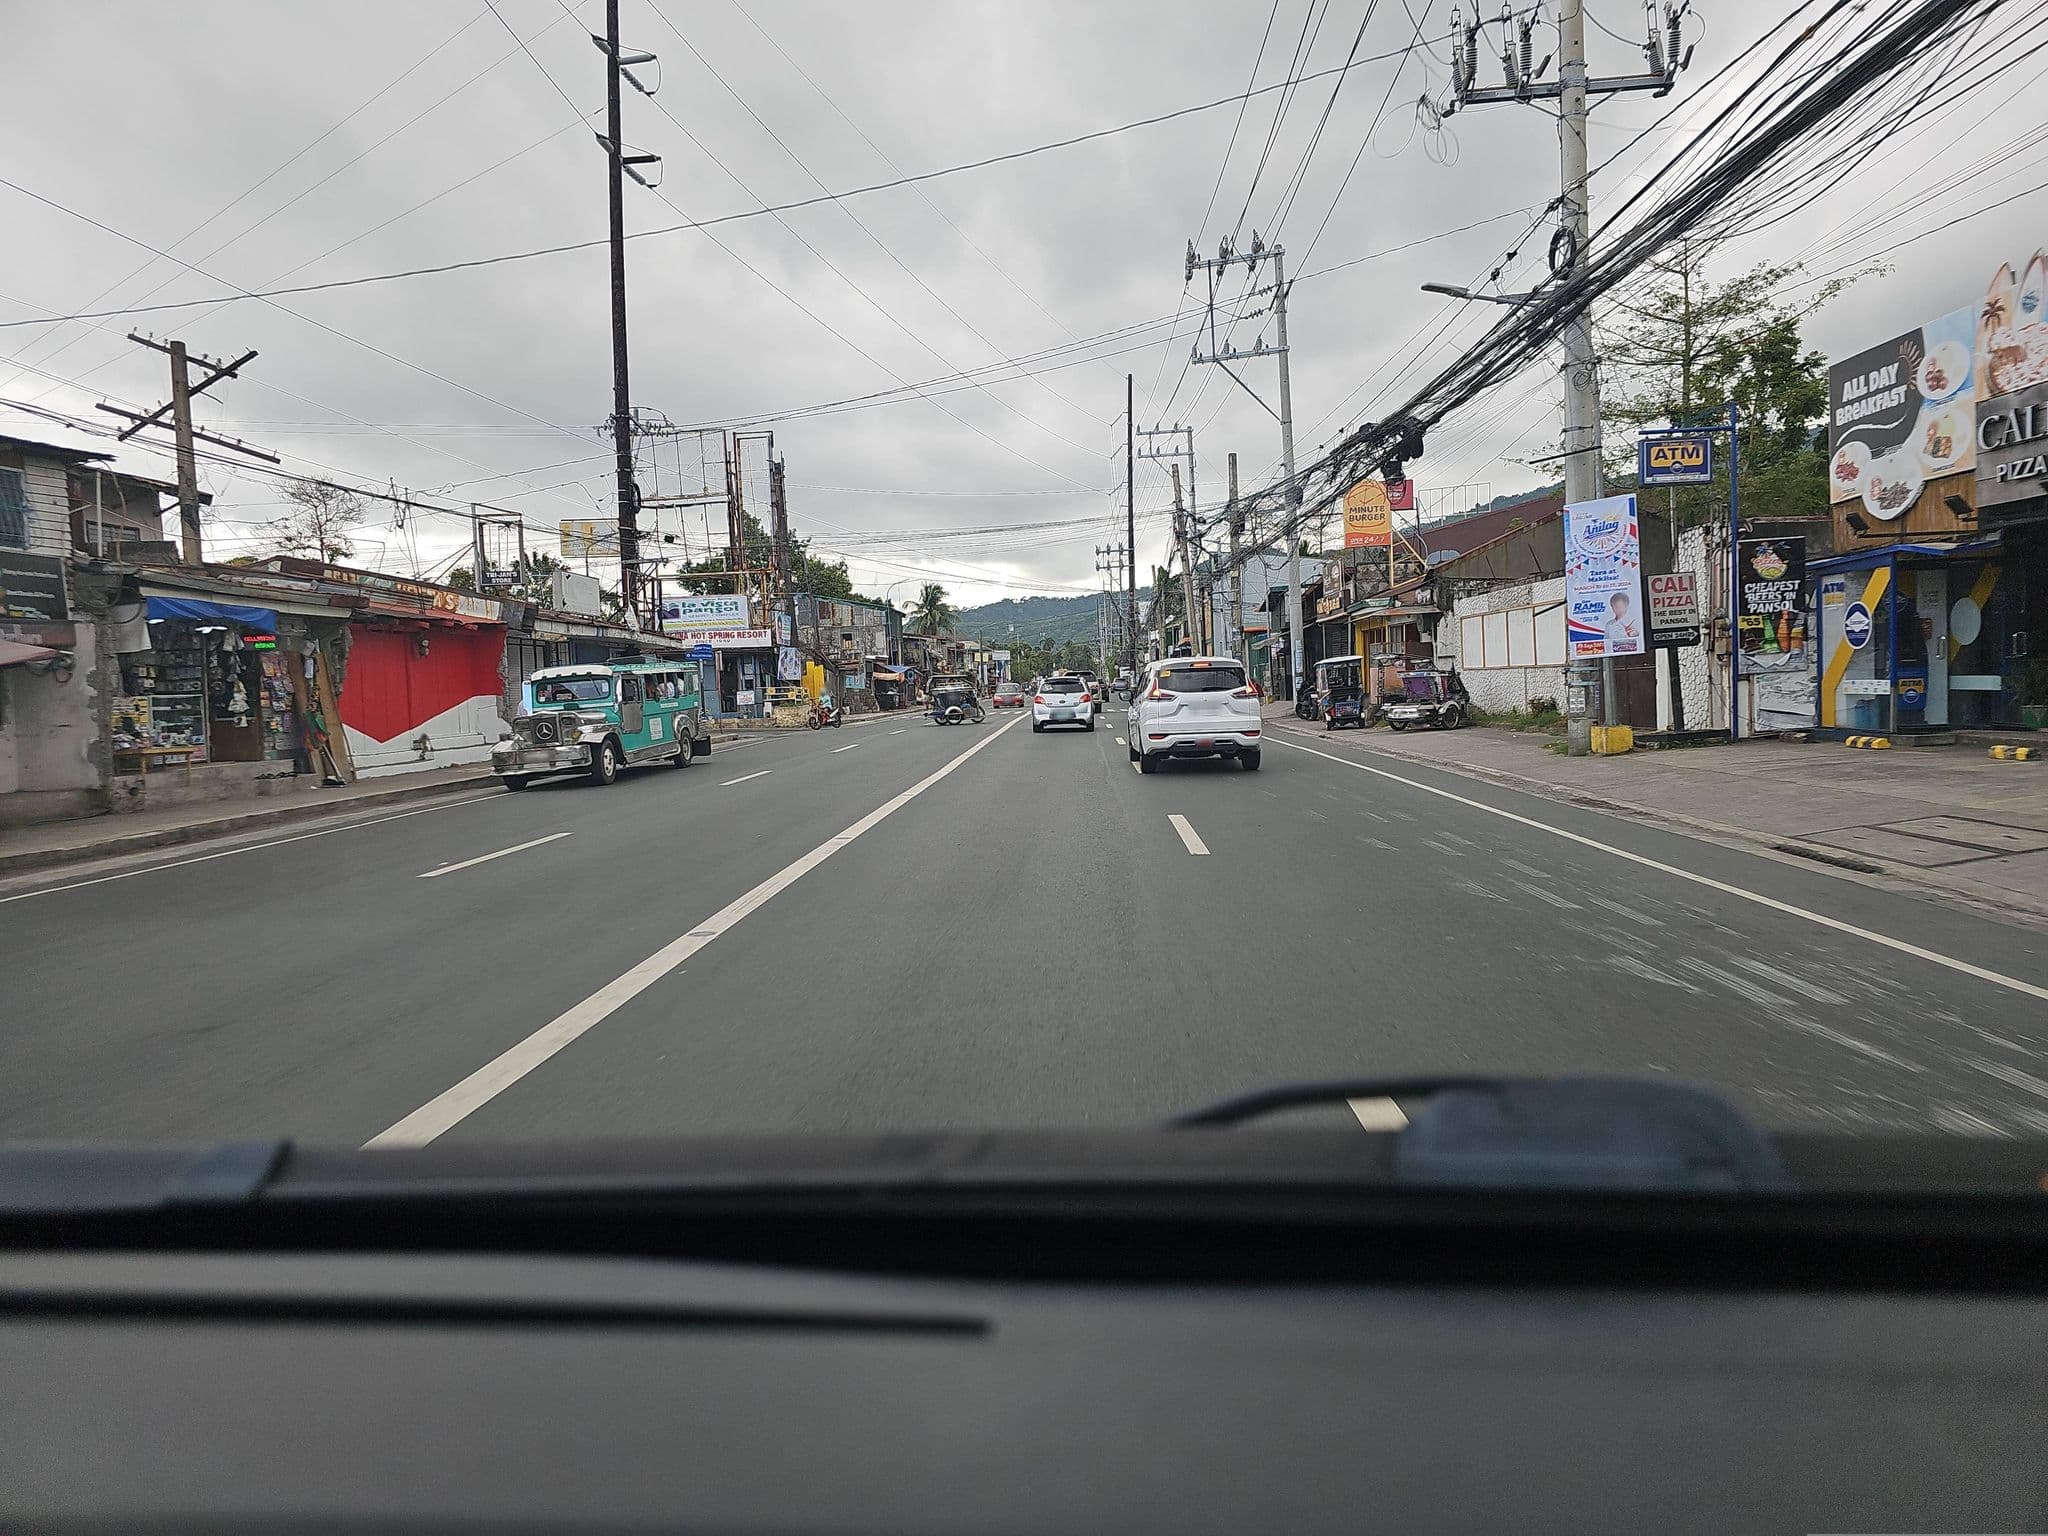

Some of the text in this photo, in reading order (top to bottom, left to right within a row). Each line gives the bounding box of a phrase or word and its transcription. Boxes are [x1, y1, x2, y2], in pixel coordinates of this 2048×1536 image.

[1842, 362, 1900, 403] ALL DAY
[1978, 401, 2048, 450] CAL
[1654, 447, 1700, 461] ATM
[1996, 455, 2048, 483] PIZZA
[1349, 505, 1385, 513] MINUTE
[1349, 513, 1386, 522] BURGER
[1651, 576, 1694, 593] CALI
[1744, 580, 1801, 593] CHEAPEST
[1822, 581, 1845, 594] ATM
[1653, 595, 1694, 608] PIZZA
[1745, 592, 1797, 602] BEERS IN
[1573, 602, 1606, 611] RAMIL
[1747, 600, 1799, 614] PANSOL
[707, 631, 735, 640] SPRING
[737, 630, 768, 639] RESORT
